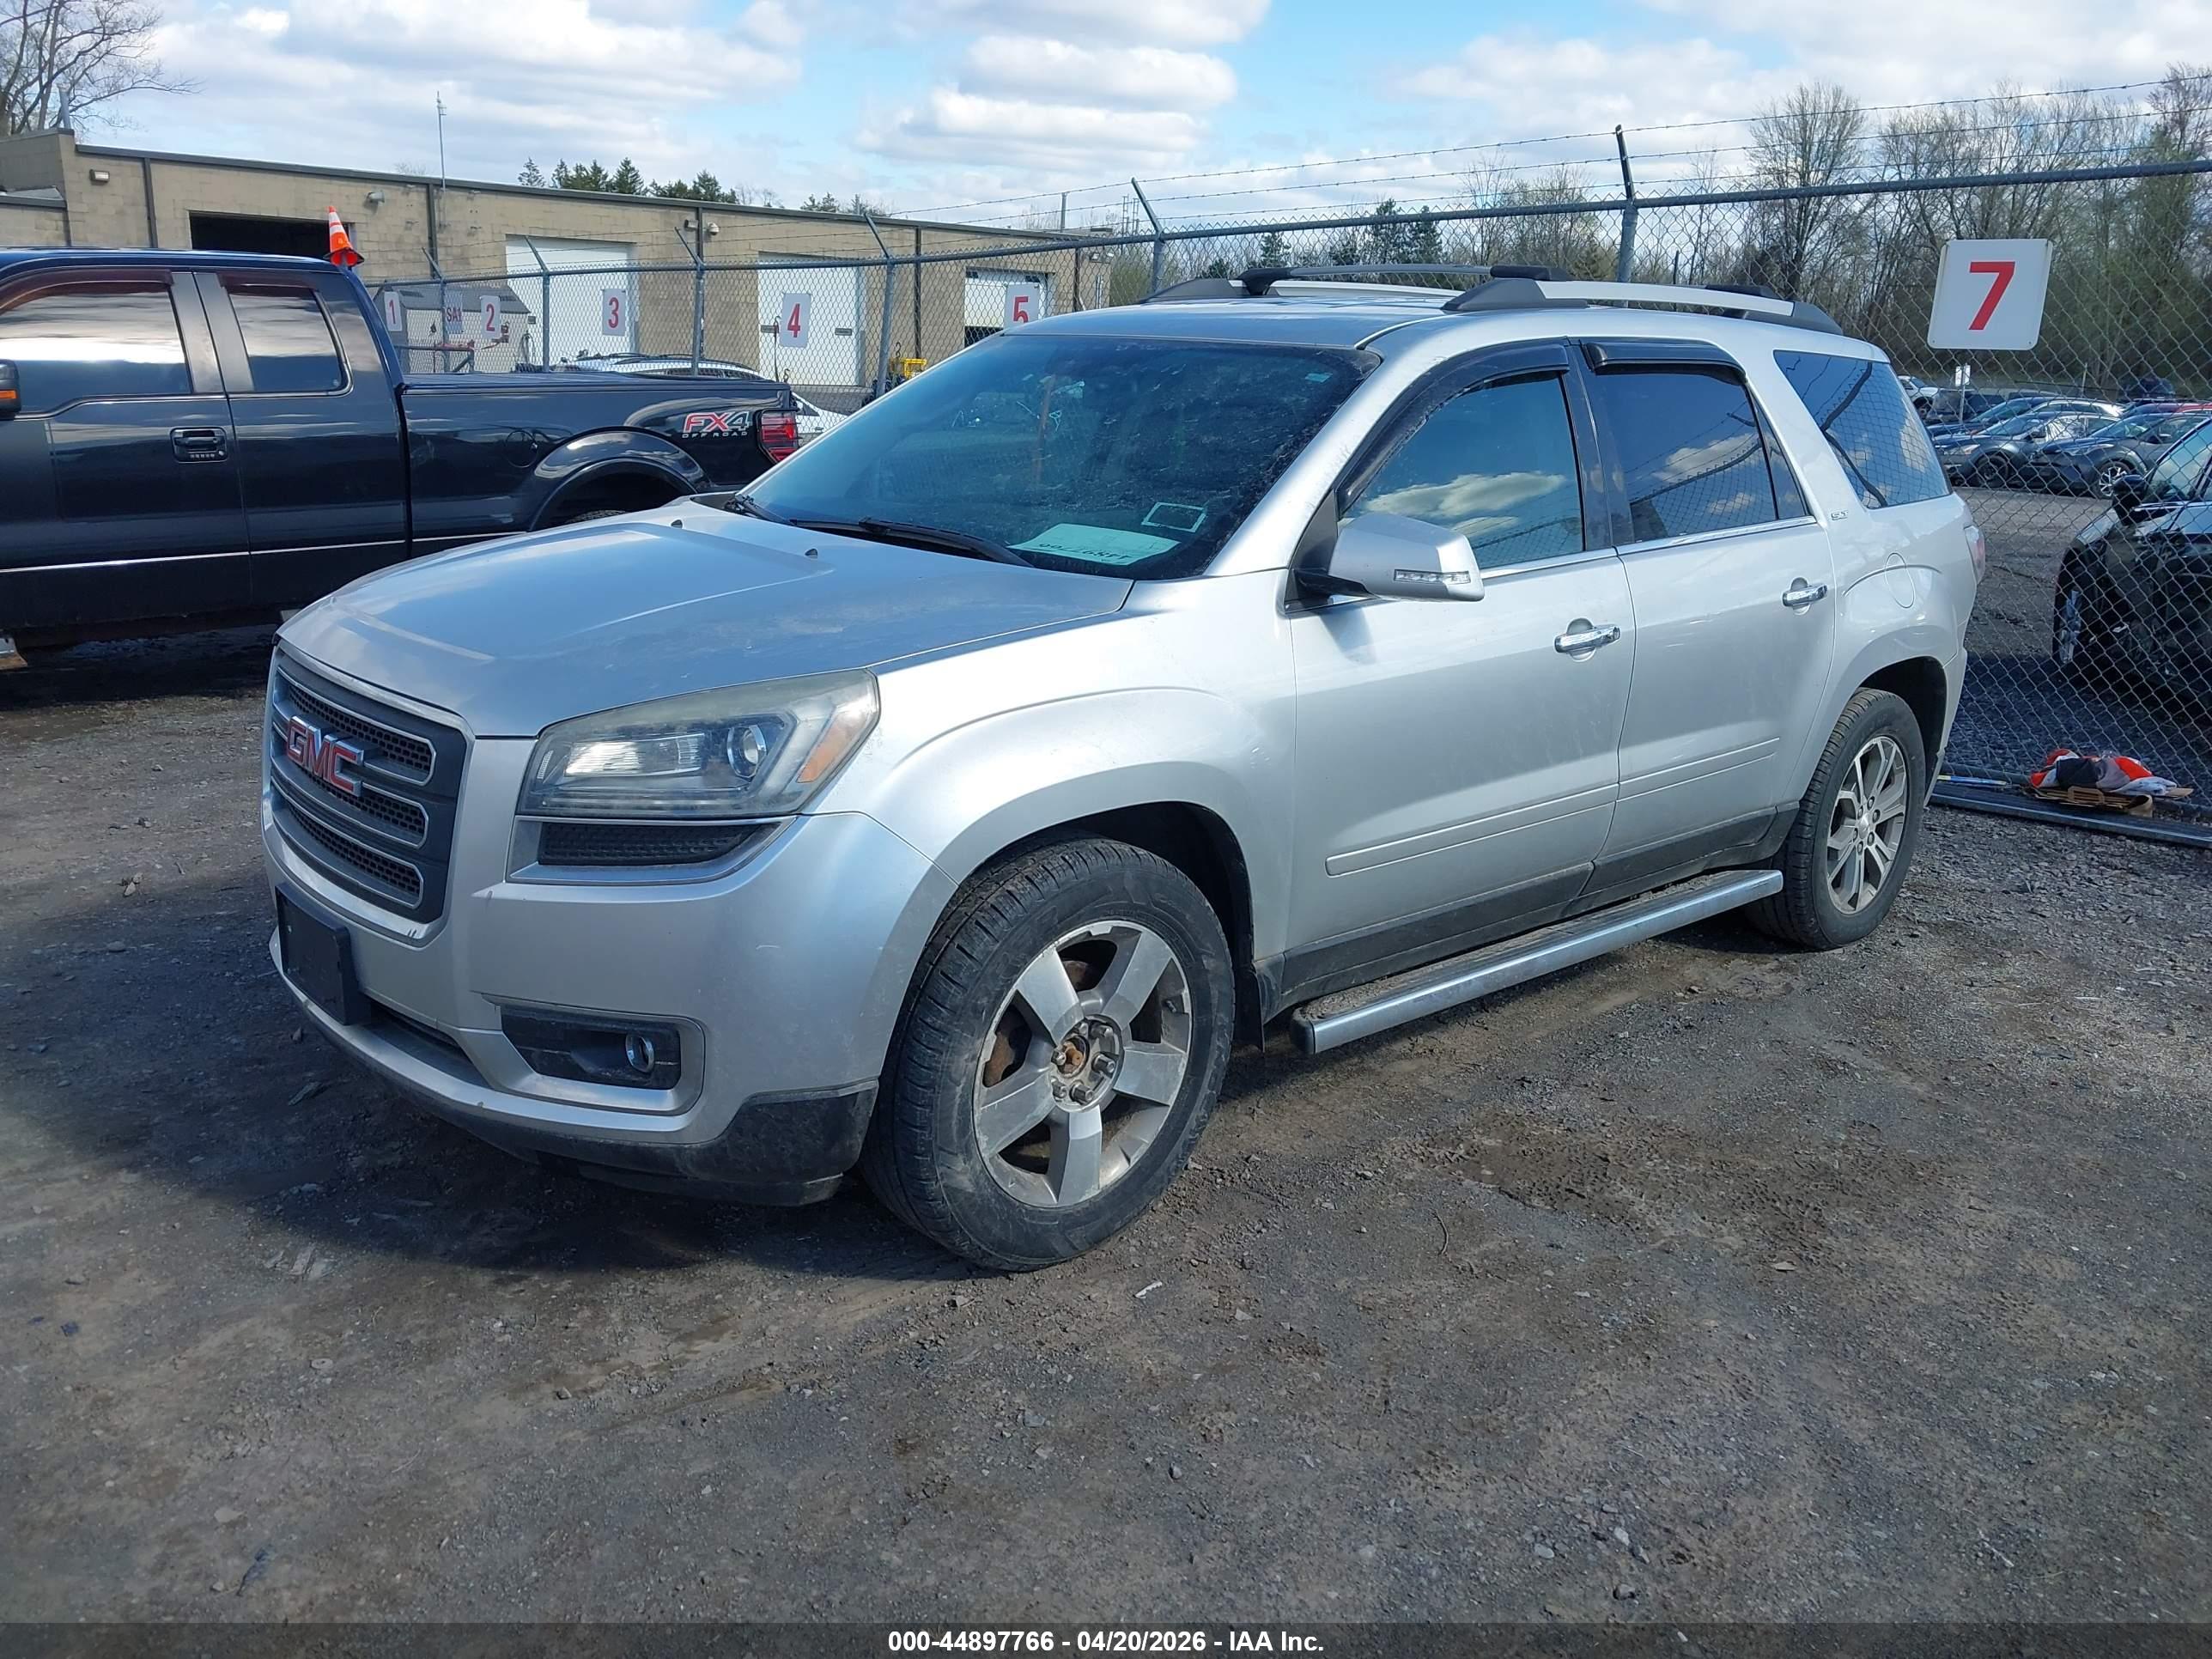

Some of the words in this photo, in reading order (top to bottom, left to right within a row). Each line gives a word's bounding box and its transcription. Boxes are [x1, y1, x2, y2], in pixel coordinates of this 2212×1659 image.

[1012, 295, 1029, 324] 5
[1968, 260, 2016, 331] 7
[388, 299, 396, 325] 1
[486, 303, 495, 331] 2
[608, 296, 619, 329] 3
[787, 302, 801, 338] 4
[684, 411, 750, 434] FX4
[288, 715, 364, 798] GMC
